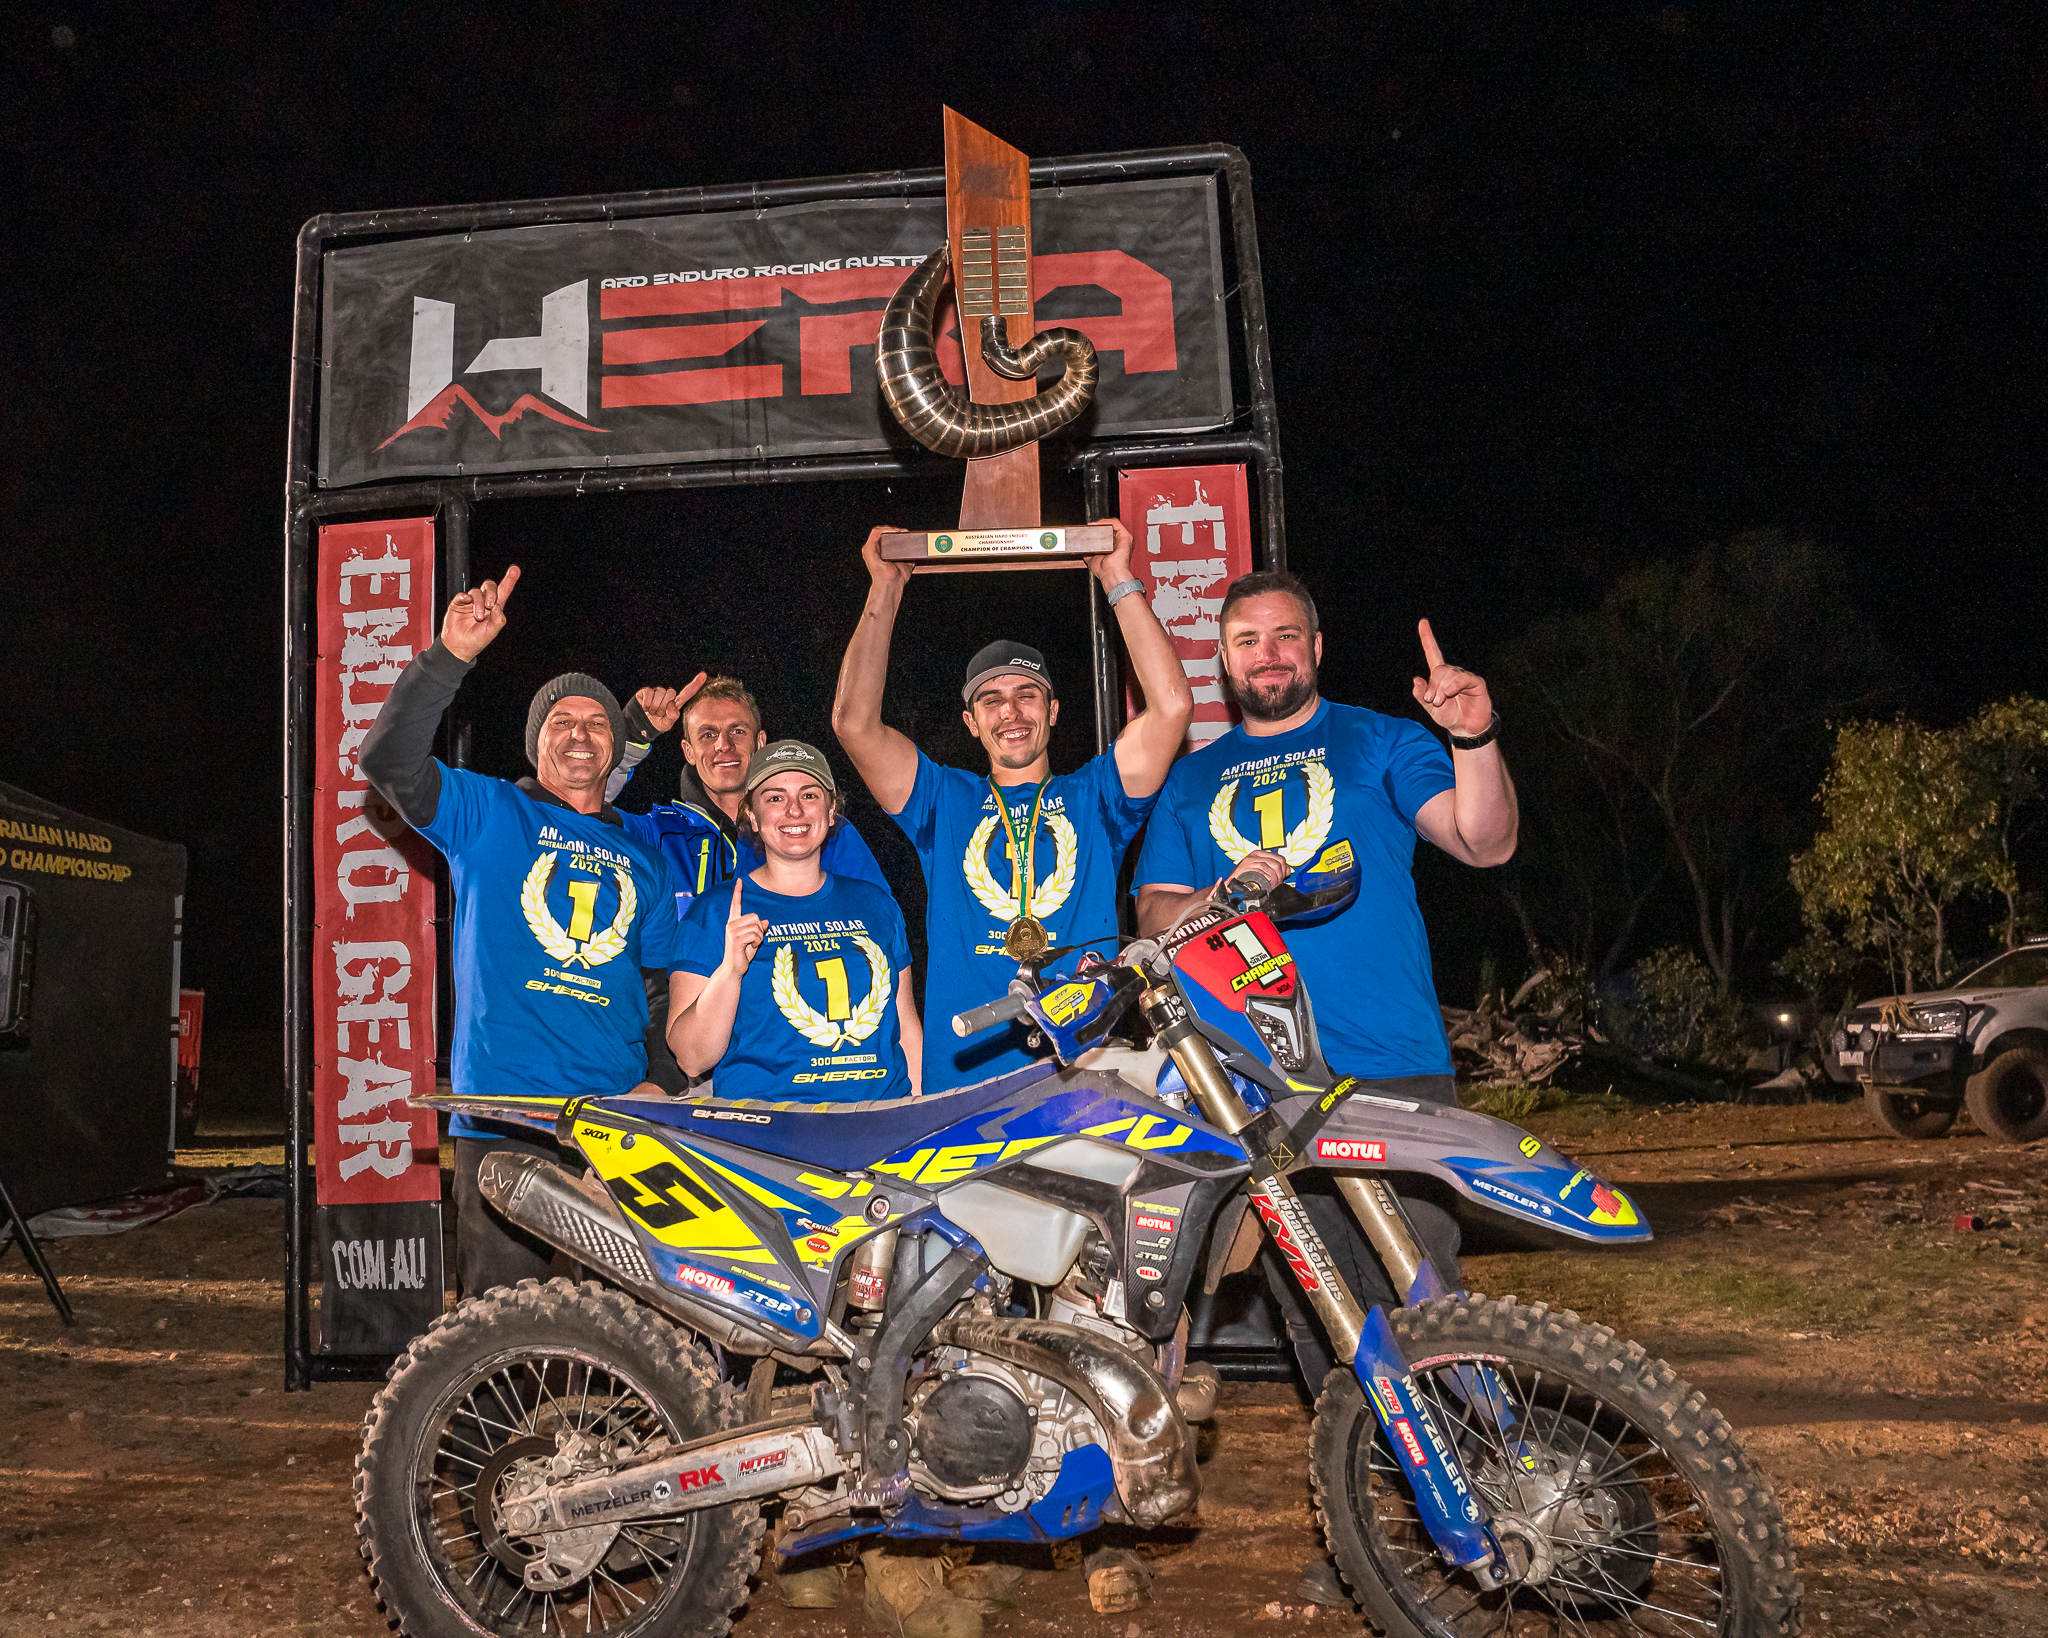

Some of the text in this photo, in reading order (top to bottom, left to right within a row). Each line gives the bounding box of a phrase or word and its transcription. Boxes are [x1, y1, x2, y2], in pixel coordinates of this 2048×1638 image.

[653, 267, 749, 286] ENDURO
[753, 258, 842, 278] RACING
[845, 254, 928, 268] AUSTR
[1219, 755, 1326, 782] AUSTRALIAN HARD ENDURO CHAMPION
[1221, 747, 1326, 777] ANTHONY SOLAR
[1252, 769, 1287, 788] 2024
[1252, 786, 1287, 850] 1
[64, 829, 112, 853] HARD
[10, 849, 132, 882] CHAMPIONSHIP
[568, 853, 602, 877] 2024
[593, 846, 631, 869] SOLAR
[567, 878, 601, 944] 1
[765, 919, 866, 938] ANTHONY SOLAR
[767, 930, 870, 943] AUSTRALIAN HARD ENDURO CHAMPION
[803, 938, 841, 953] 2024
[571, 975, 600, 987] FACTORY
[1230, 952, 1293, 994] CHAMPION
[524, 979, 611, 1007] SHERCO
[813, 956, 853, 1023] 1
[331, 940, 413, 1181] GEAR
[811, 1055, 876, 1067] 300 FACTORY
[791, 1068, 888, 1084] SHERCO
[692, 1108, 773, 1125] SHERCO
[1320, 1140, 1383, 1160] MOTUL
[1472, 1178, 1540, 1211] METZELER
[1137, 1216, 1172, 1231] MOTUL
[331, 1237, 427, 1290] COM.AU
[1277, 1199, 1312, 1241] Road
[1303, 1240, 1328, 1270] Set
[1320, 1269, 1346, 1301] Ups
[679, 1267, 732, 1294] MOTUL
[730, 1265, 792, 1291] ANTHONY SOLAR
[1139, 1268, 1159, 1278] BELL
[751, 1290, 793, 1312] TSP
[1380, 1378, 1402, 1412] NITRO
[1396, 1421, 1425, 1465] MOTUL
[1401, 1374, 1467, 1496] METZELER
[740, 1450, 786, 1472] NITRO
[679, 1463, 724, 1491] RK
[570, 1488, 652, 1519] METZELER
